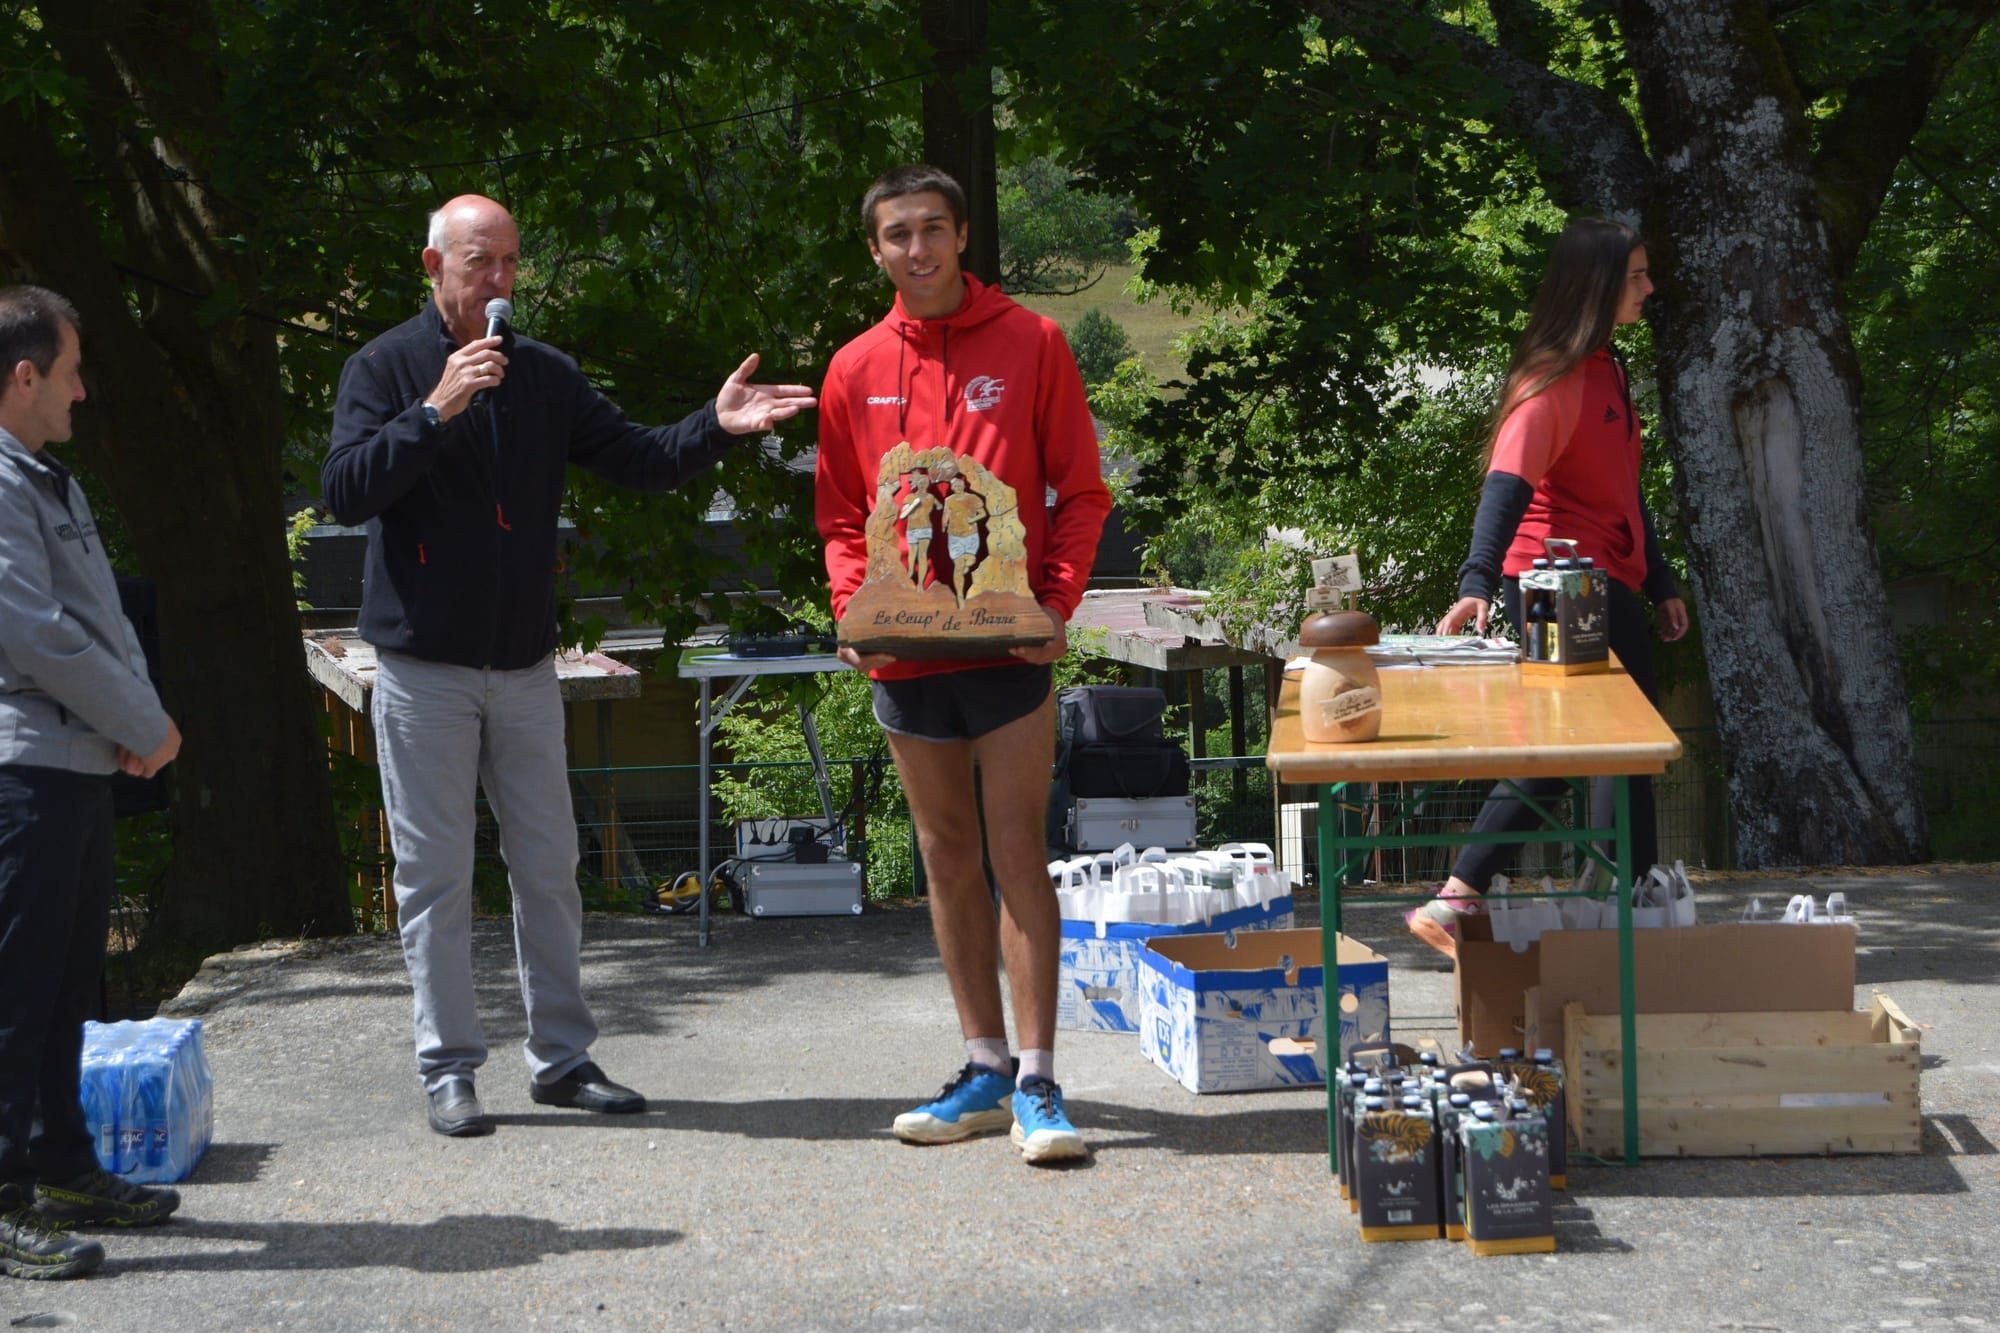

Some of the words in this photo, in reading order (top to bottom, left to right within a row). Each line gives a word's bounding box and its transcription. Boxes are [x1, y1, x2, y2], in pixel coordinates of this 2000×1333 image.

[866, 395, 898, 405] CRAFT
[873, 610, 892, 625] Le
[942, 615, 961, 631] de
[969, 607, 1017, 626] Barre
